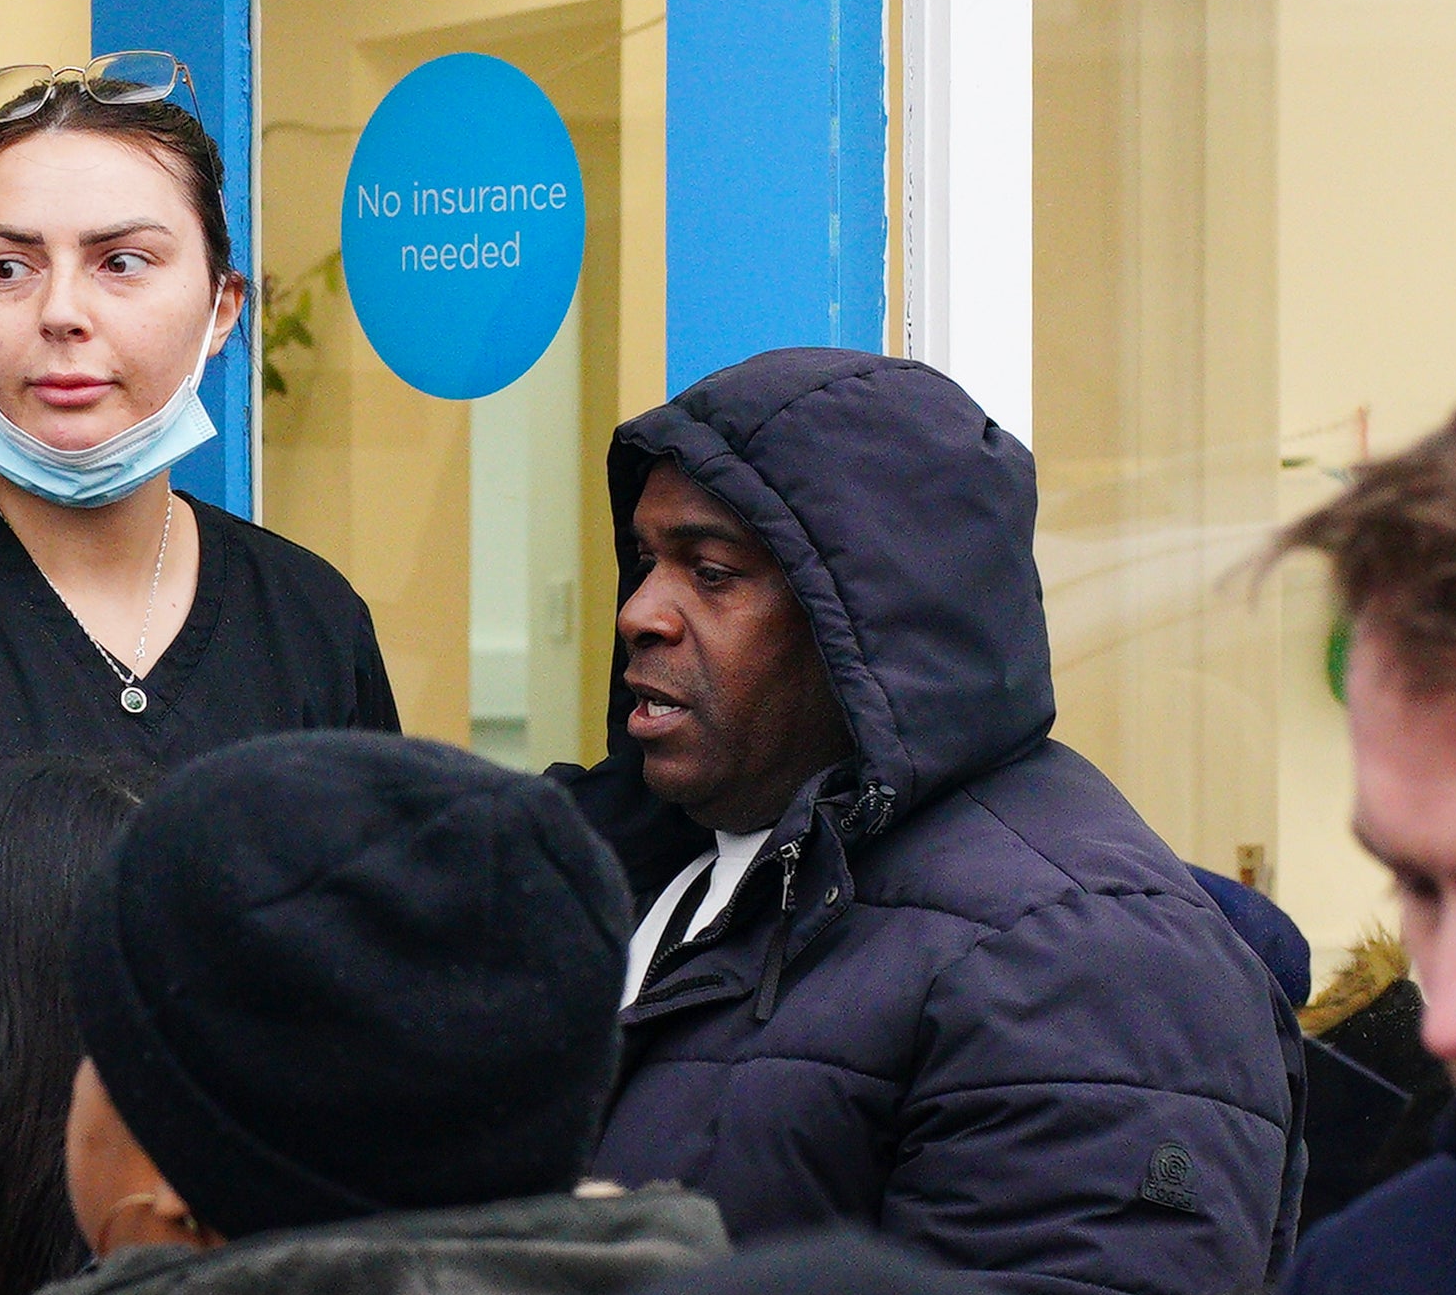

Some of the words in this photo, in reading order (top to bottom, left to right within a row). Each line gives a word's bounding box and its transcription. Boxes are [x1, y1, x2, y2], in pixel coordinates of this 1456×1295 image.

[358, 183, 402, 219] No
[412, 180, 568, 217] insurance
[401, 230, 521, 271] needed
